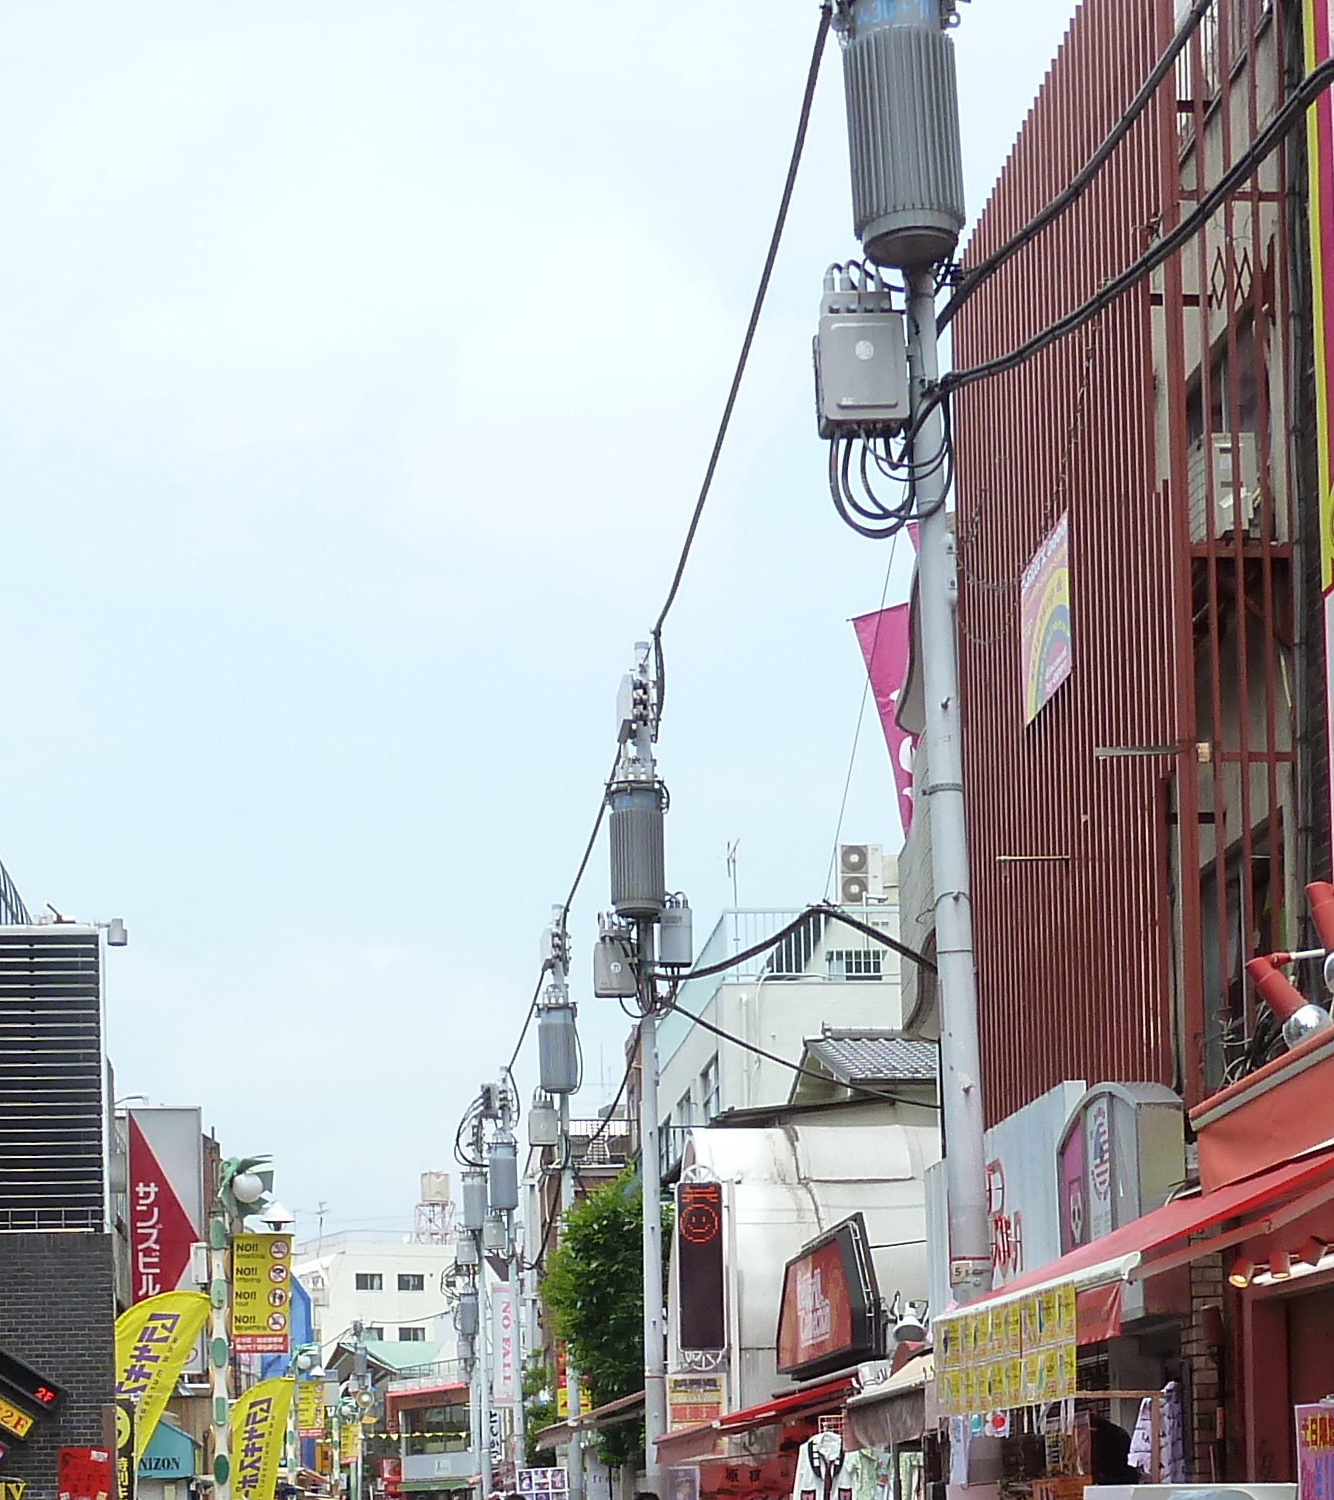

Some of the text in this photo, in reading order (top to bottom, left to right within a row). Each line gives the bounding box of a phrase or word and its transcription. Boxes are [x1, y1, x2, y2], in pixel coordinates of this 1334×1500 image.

[135, 1182, 161, 1298] サンズビル
[236, 1243, 259, 1252] NO!!
[235, 1267, 257, 1276] NO!!
[235, 1291, 257, 1300] NO!!
[234, 1315, 256, 1324] NO!!
[501, 1302, 513, 1382] NO FALL
[34, 1386, 56, 1405] 2F
